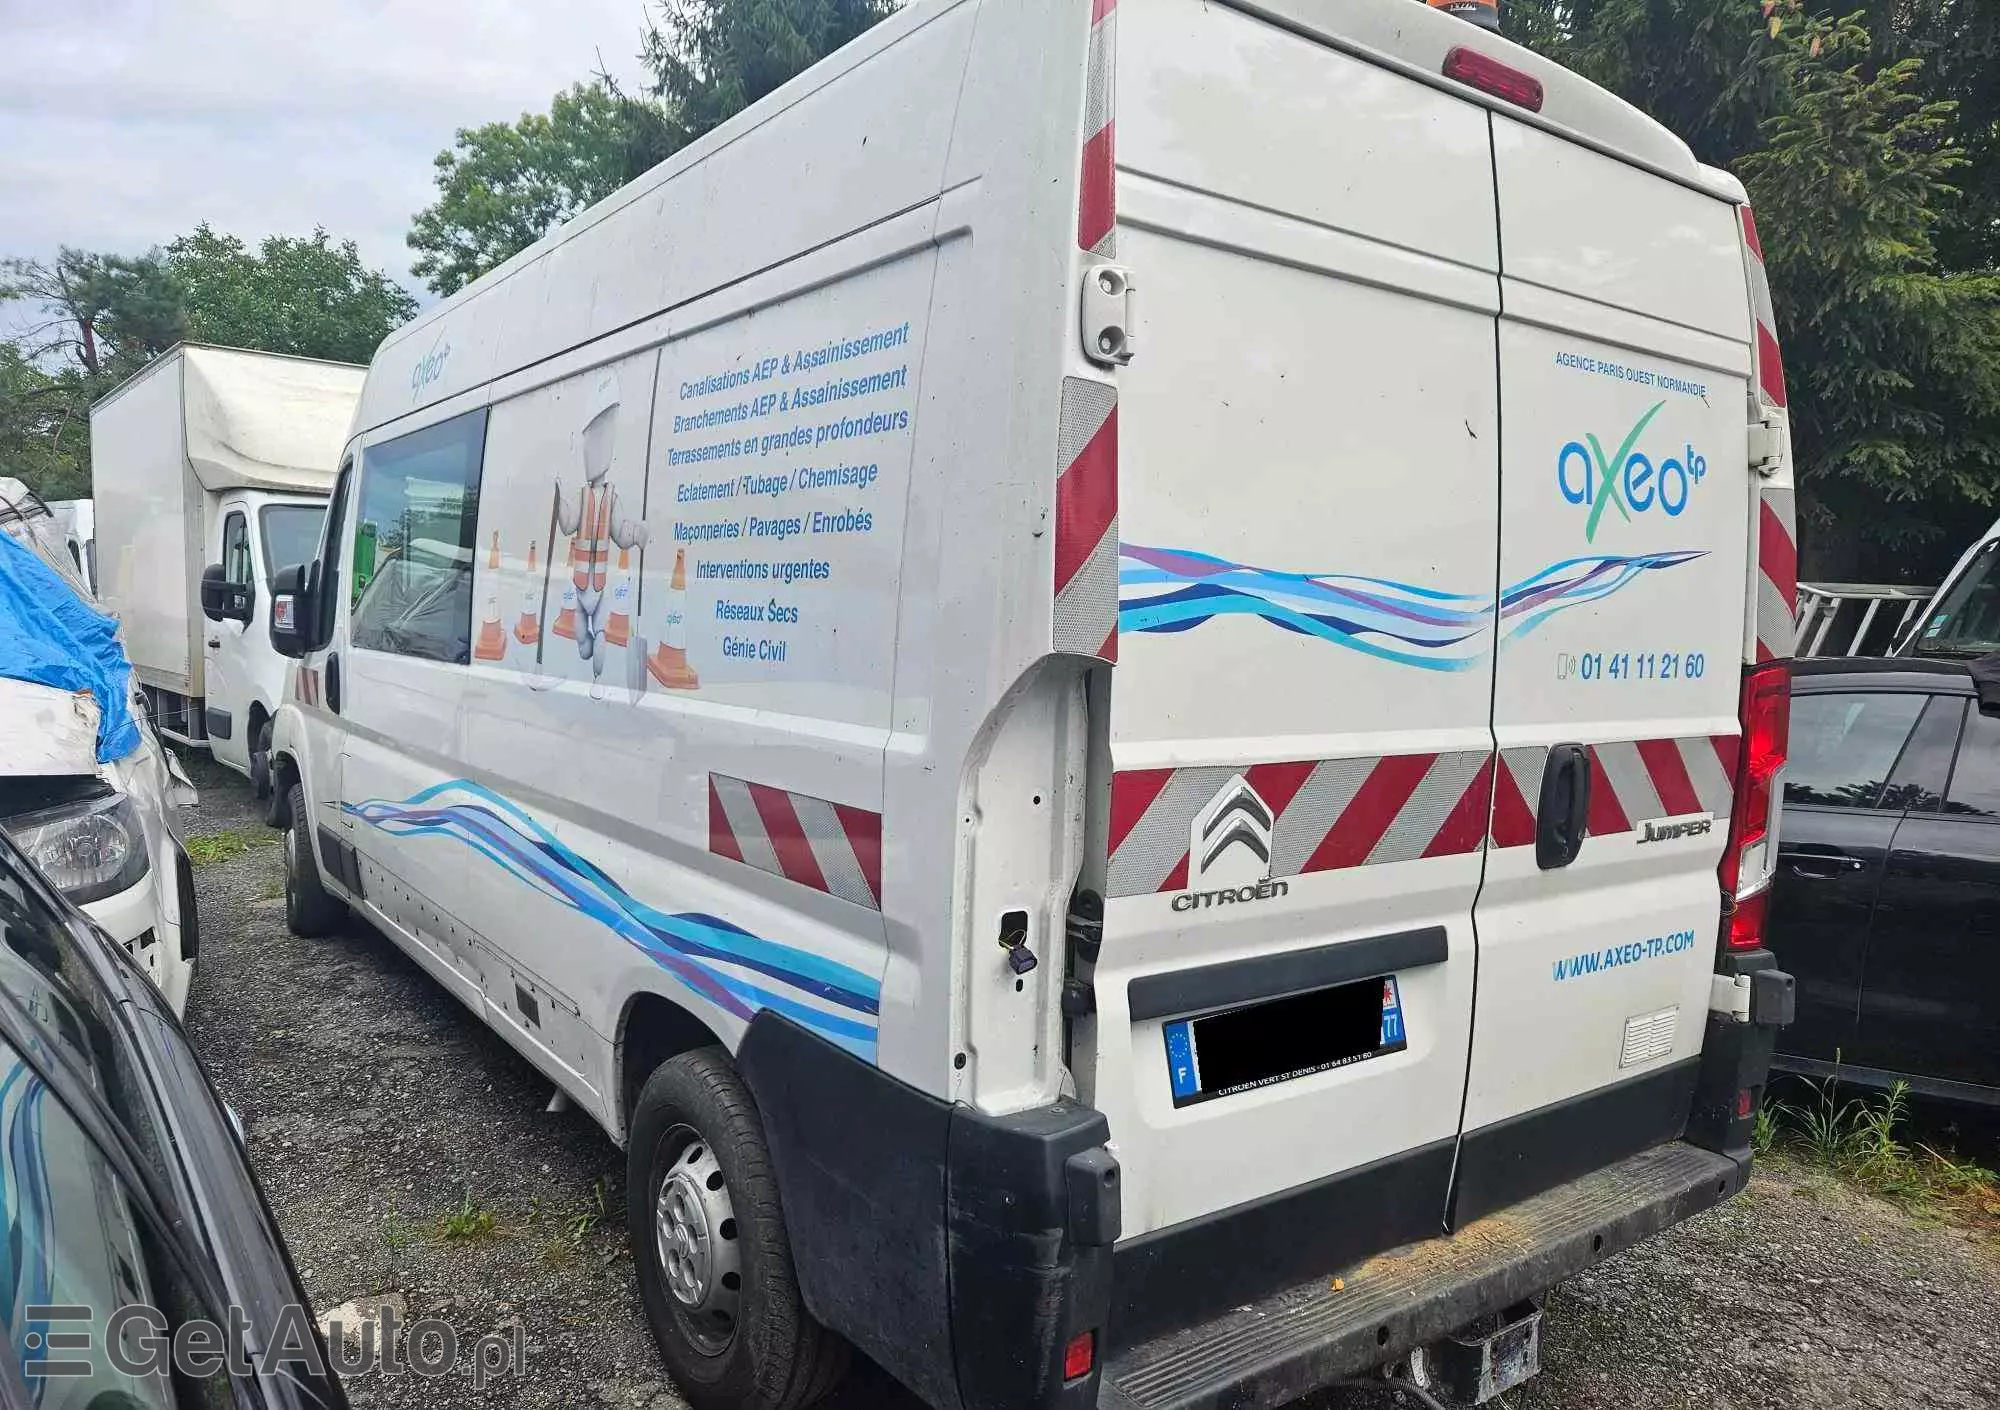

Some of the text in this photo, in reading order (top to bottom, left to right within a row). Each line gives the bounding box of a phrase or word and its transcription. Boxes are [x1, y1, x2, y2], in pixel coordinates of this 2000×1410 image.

[680, 321, 909, 401] Canalisations AEP & Assainissement
[1556, 351, 1707, 396] AGENCE PARIS OUEST NORMANDIE
[673, 364, 908, 434] Branchements AEP & Assainissement
[667, 409, 909, 467] Terrassements en grandes profondeurs
[677, 478, 735, 503] Eclatement
[744, 472, 788, 498] Tubage
[798, 463, 878, 490] Chemisage
[674, 516, 740, 545] Maçonneries
[749, 516, 801, 541] Pavages
[812, 507, 873, 533] Enrobés
[696, 559, 830, 584] Interventions urgentes
[716, 599, 798, 623] Réseaux Secs
[723, 634, 787, 662] Génie Civil
[1582, 653, 1705, 680] 01 41 11 21 60
[1552, 928, 1695, 981] WWW.AXEO-TP.COM
[1383, 1014, 1398, 1038] 77
[1178, 1066, 1187, 1085] F
[1258, 1074, 1280, 1086] VERT
[1292, 1065, 1316, 1077] DENIS
[1320, 1062, 1330, 1070] 01
[1331, 1059, 1341, 1067] 64
